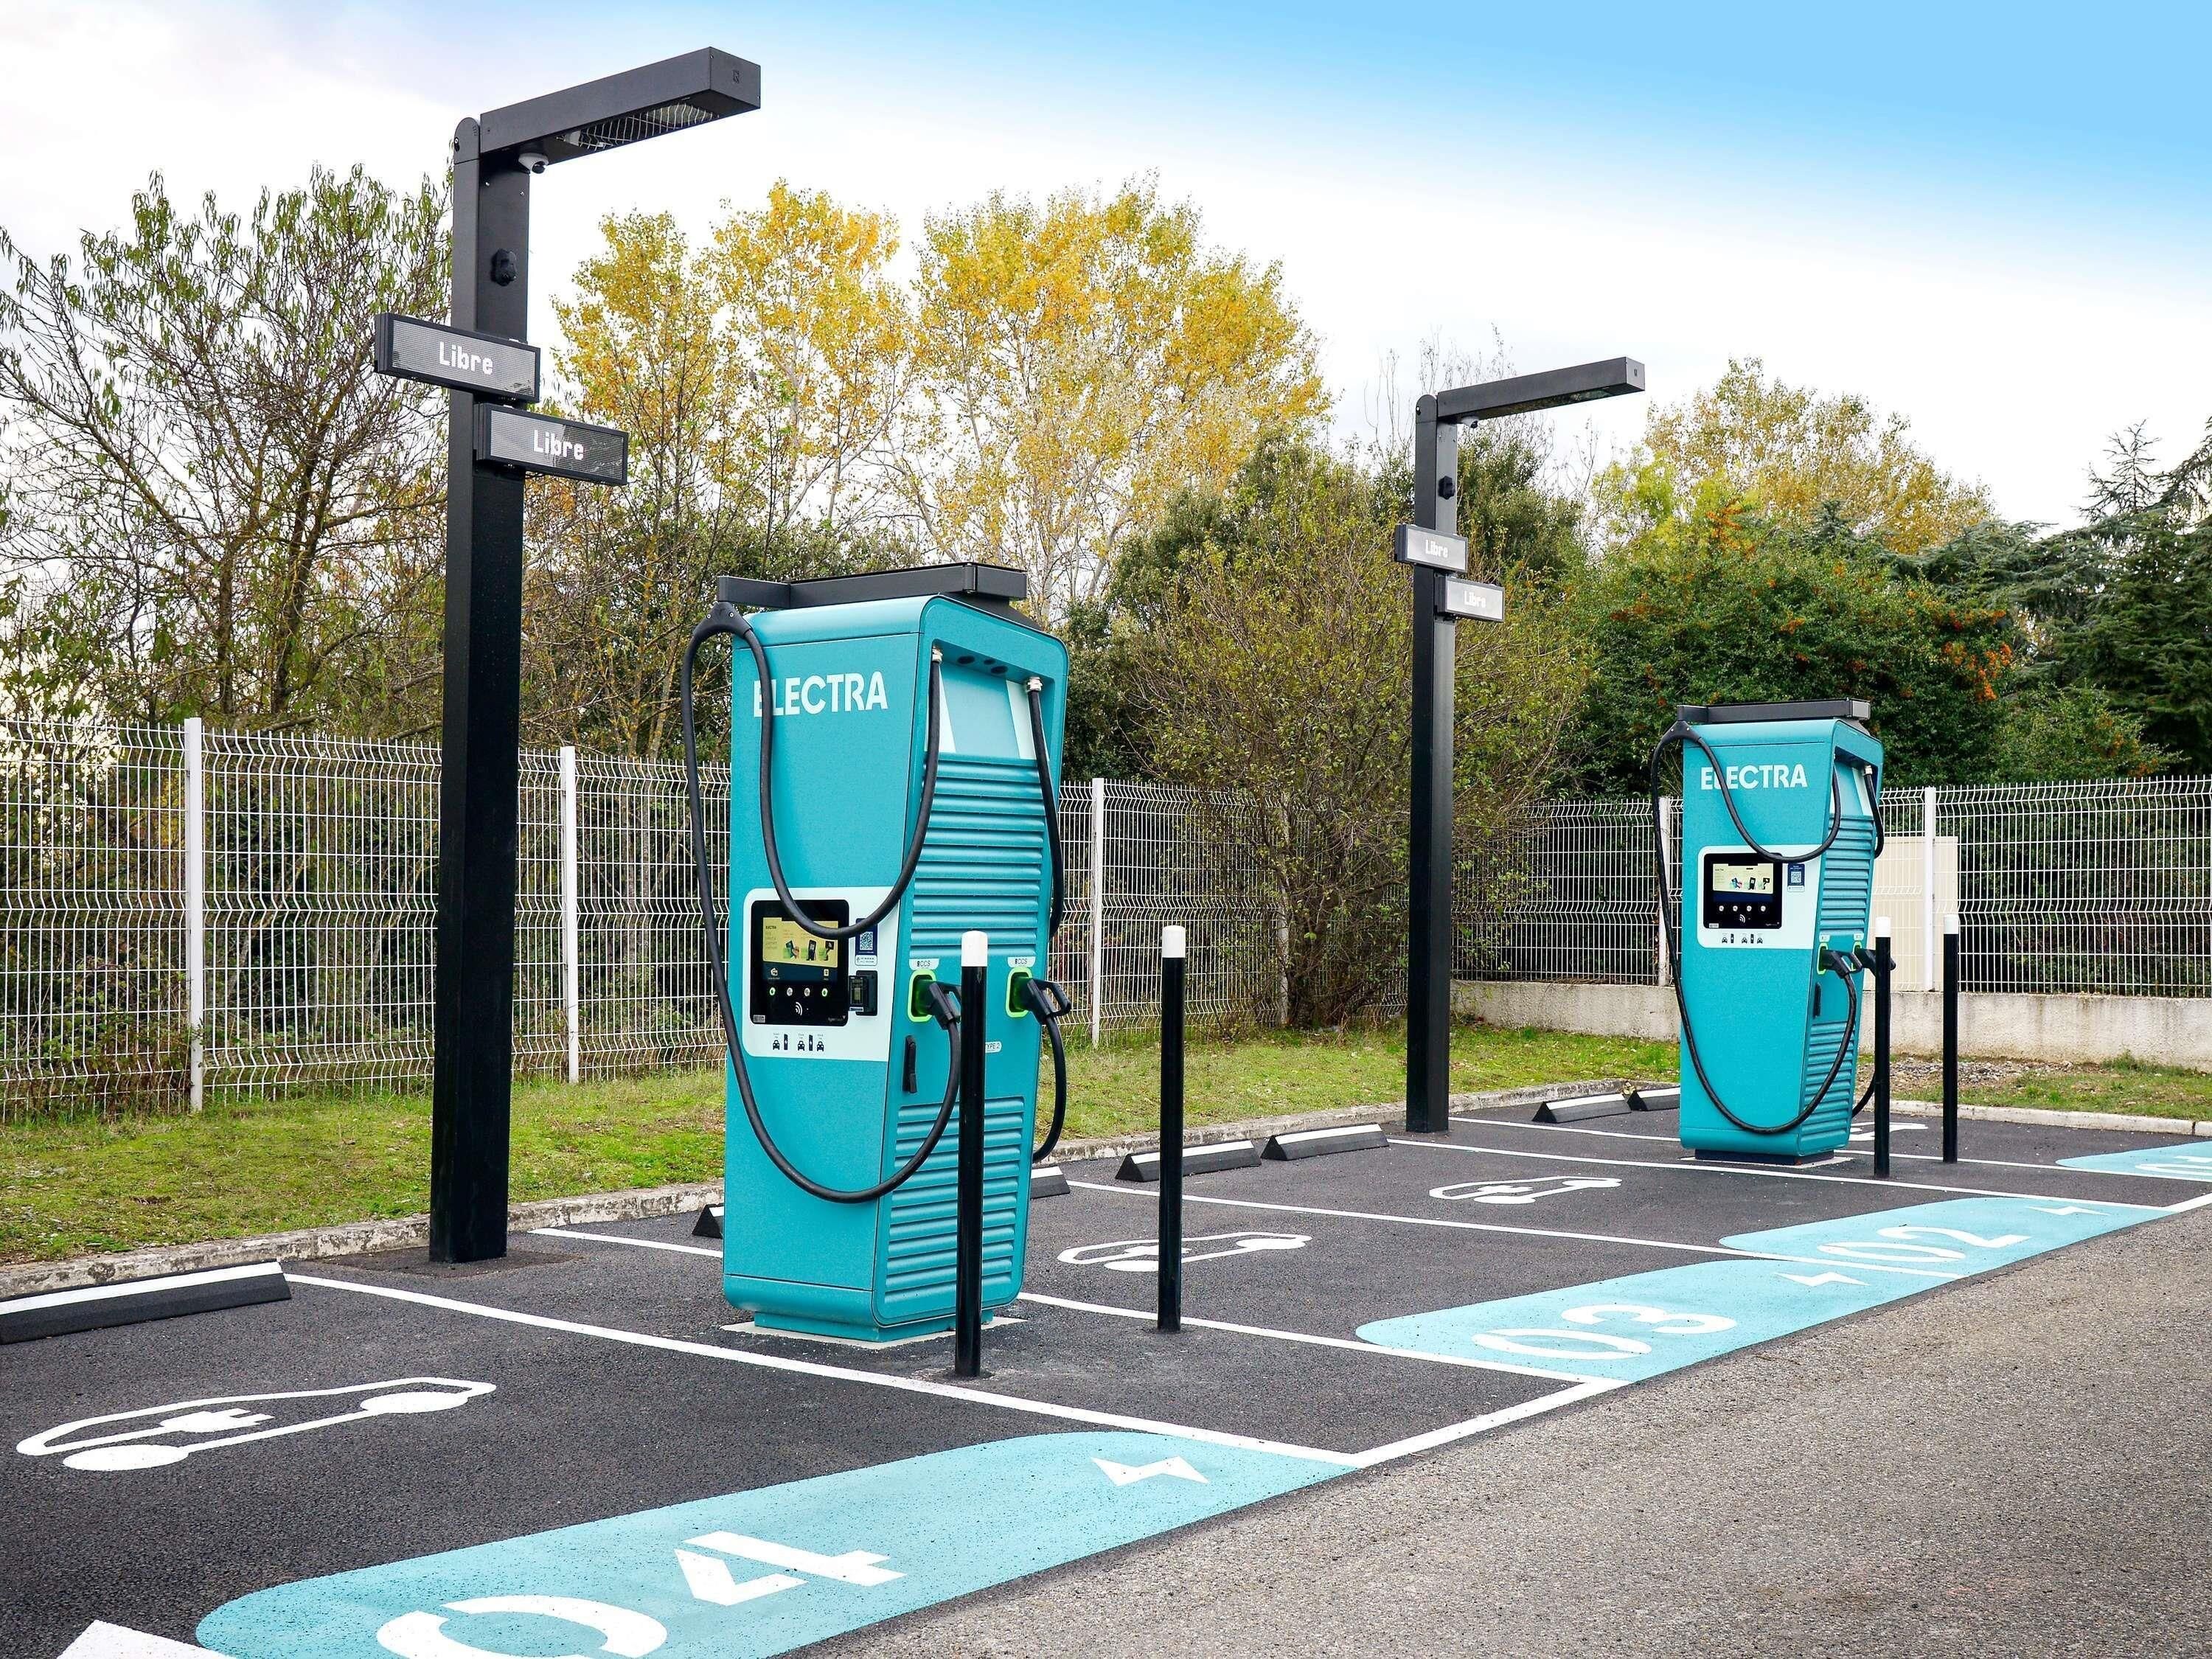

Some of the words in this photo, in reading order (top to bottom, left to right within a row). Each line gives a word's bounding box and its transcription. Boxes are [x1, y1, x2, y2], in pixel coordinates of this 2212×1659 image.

[439, 341, 494, 375] Libre
[533, 430, 584, 459] Libre
[1425, 539, 1449, 558] Libre
[1464, 590, 1486, 608] Libre
[754, 671, 888, 717] ELECTRA
[1817, 1226, 2033, 1263] 02
[1471, 1304, 1738, 1360] 03
[377, 1531, 907, 1659] 04
